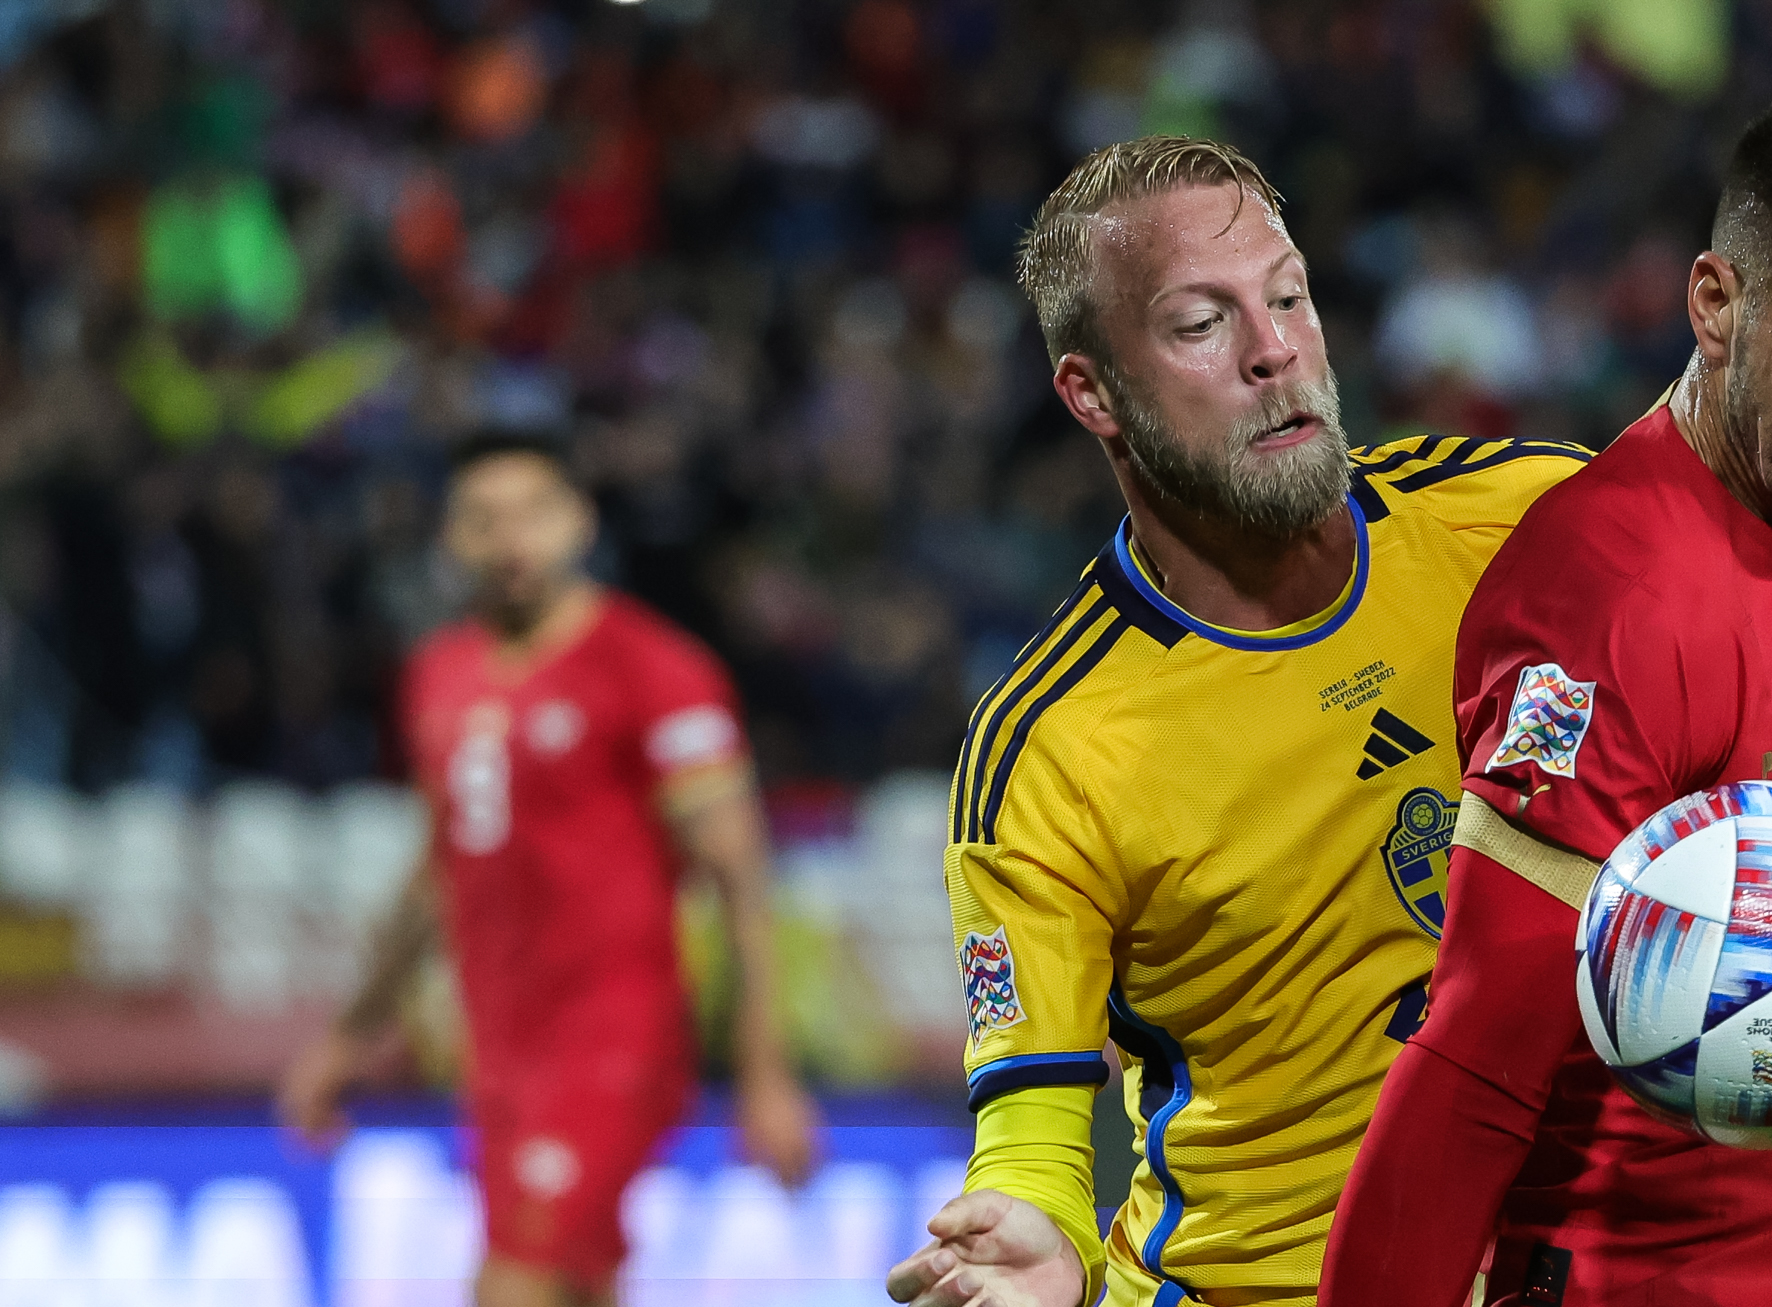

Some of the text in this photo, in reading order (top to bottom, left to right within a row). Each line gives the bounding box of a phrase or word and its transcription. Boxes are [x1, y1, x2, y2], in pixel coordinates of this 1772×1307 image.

[1319, 679, 1348, 699] SERBIA
[1353, 660, 1385, 681] SWEDEN
[1320, 667, 1396, 712] 24 SEPTEMBER 2022
[1344, 687, 1383, 711] BELGRADE
[1402, 832, 1452, 860] SVERIG
